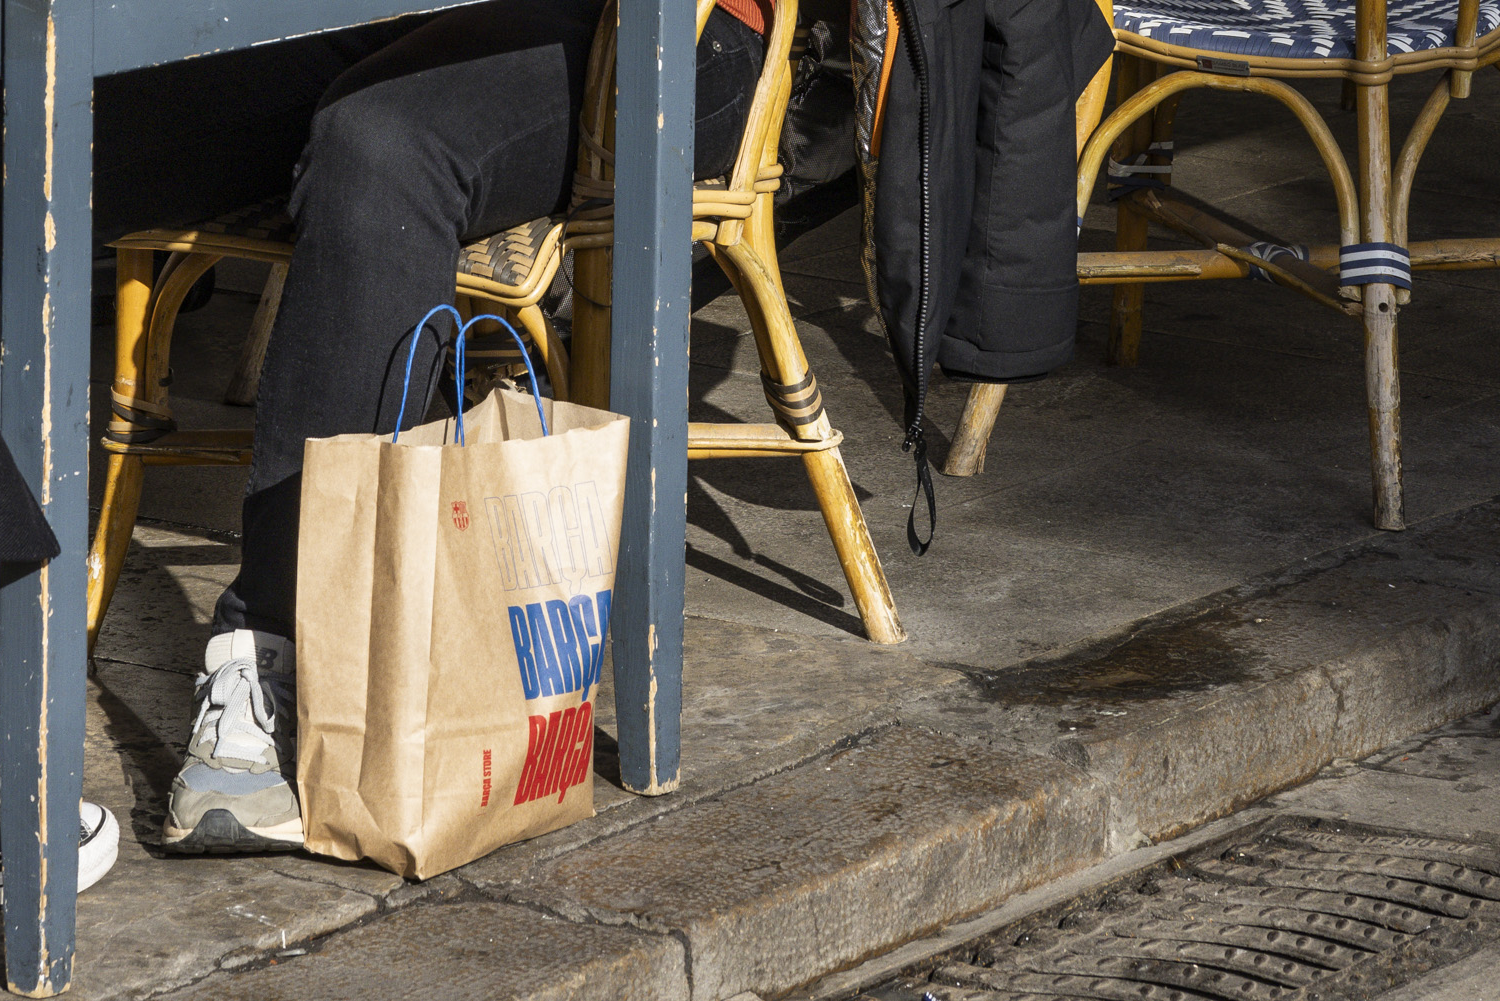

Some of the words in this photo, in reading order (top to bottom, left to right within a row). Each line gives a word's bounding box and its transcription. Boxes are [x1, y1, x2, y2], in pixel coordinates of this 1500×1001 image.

[484, 480, 613, 595] BARÇA
[482, 748, 492, 777] STORE
[513, 701, 593, 806] BARÇA
[481, 777, 492, 807] BARÇA
